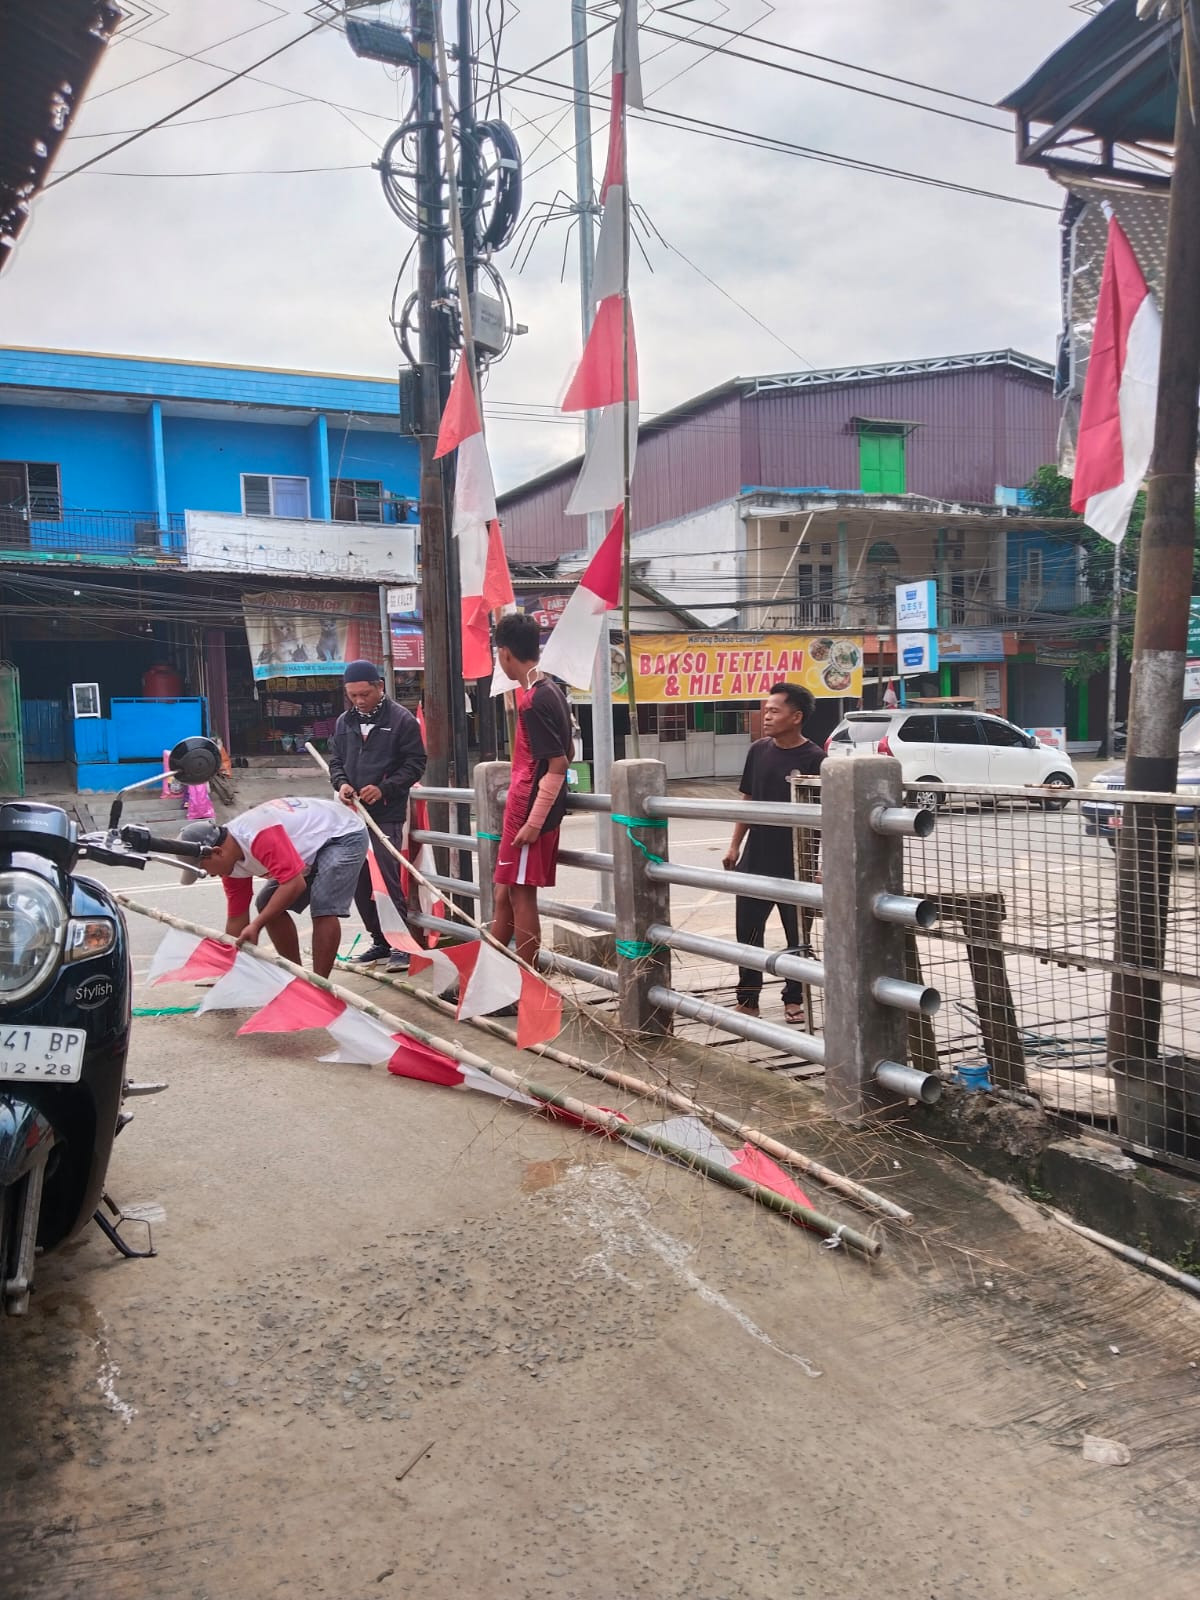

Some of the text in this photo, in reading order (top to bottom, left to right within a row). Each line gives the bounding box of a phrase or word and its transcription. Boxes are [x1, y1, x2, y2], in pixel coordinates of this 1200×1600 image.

[540, 614, 549, 627] 5
[638, 650, 805, 675] BAKSO TETELAN
[664, 671, 787, 697] & MIE AYAM
[12, 818, 49, 827] HONDA
[75, 983, 113, 1001] Stylish
[0, 1030, 79, 1054] 41 BP
